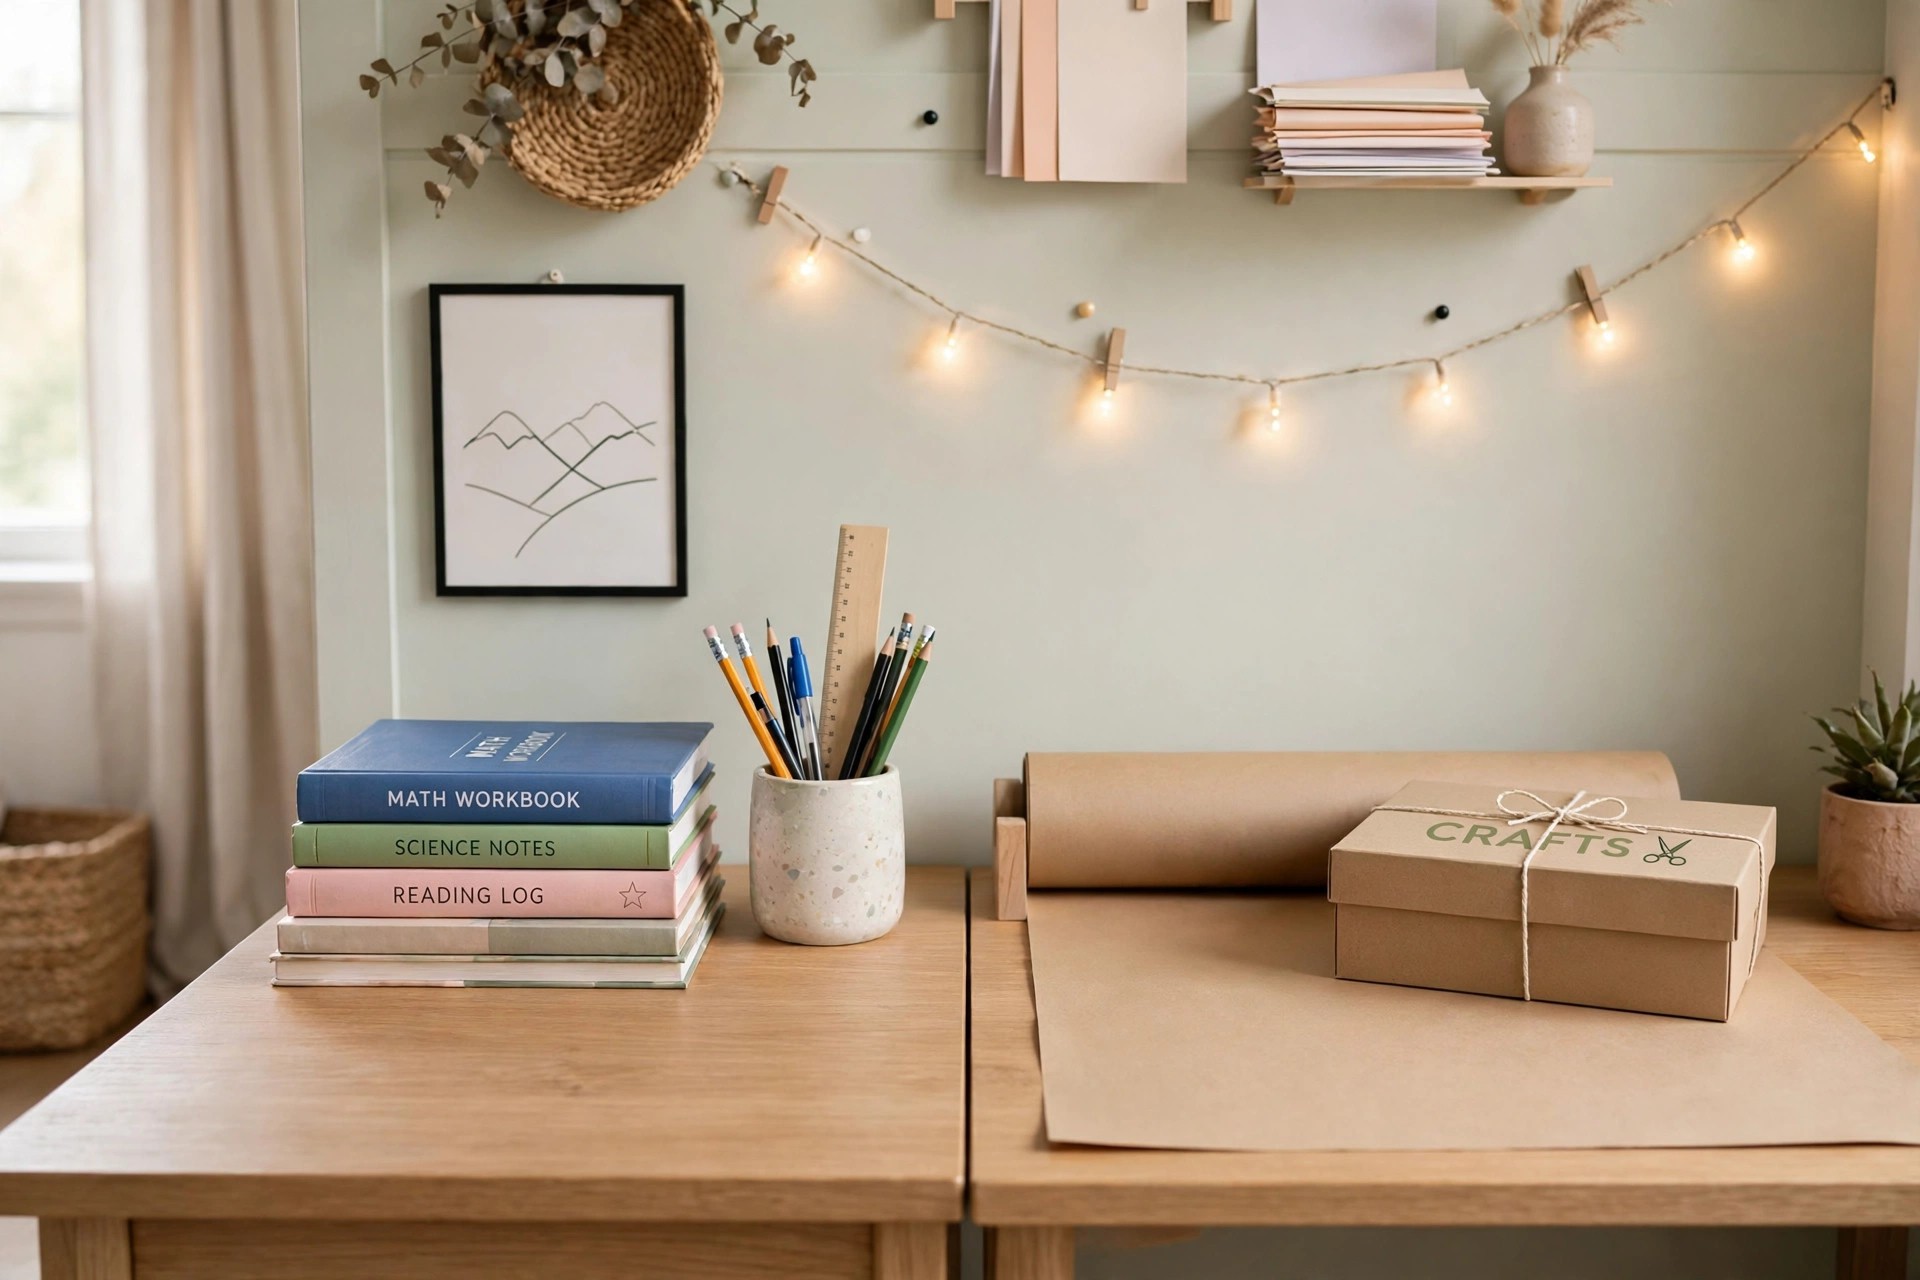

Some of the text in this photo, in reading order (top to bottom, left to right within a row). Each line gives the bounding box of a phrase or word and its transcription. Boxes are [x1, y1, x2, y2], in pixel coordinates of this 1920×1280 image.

[387, 790, 581, 809] MATH WORKBOOK
[395, 839, 556, 857] SCIENCE NOTES
[1426, 821, 1634, 858] CRAFTS
[393, 886, 544, 905] READING LOG
